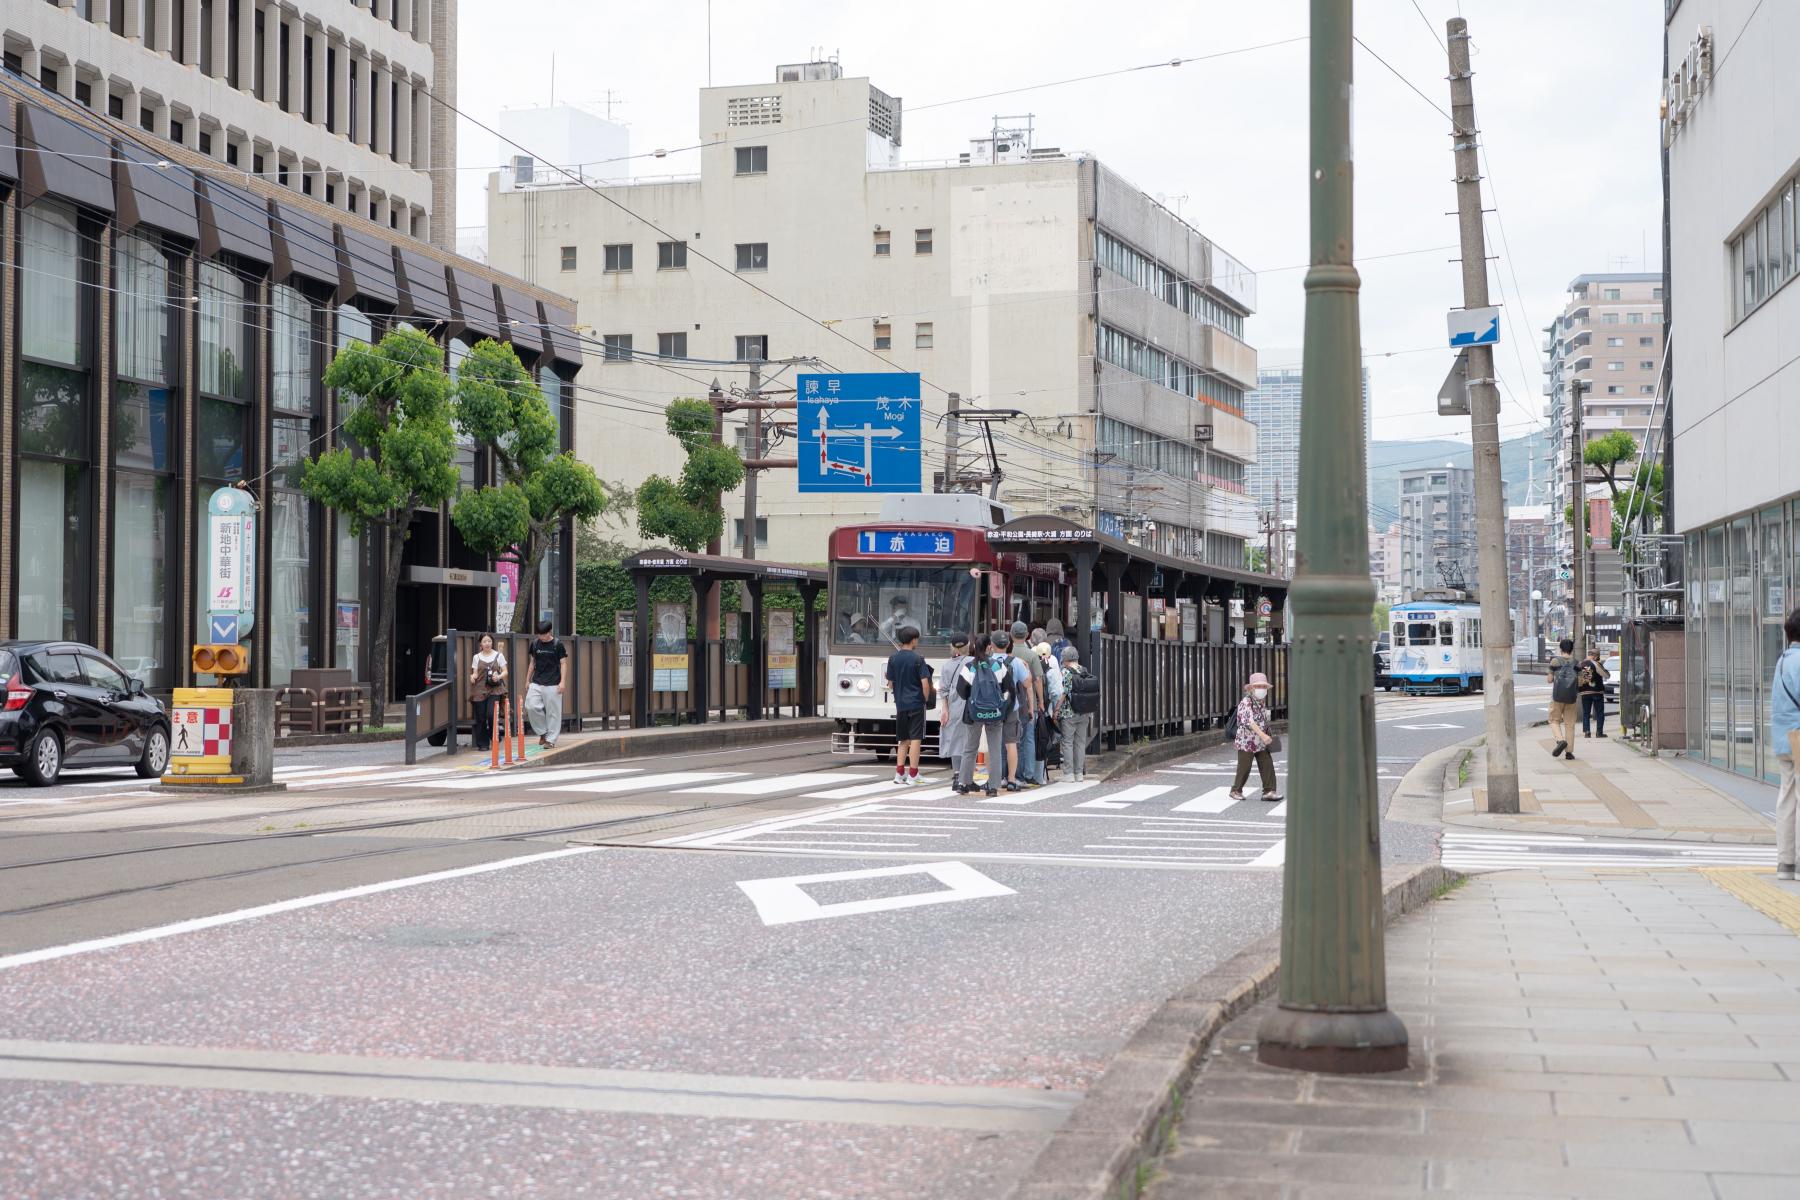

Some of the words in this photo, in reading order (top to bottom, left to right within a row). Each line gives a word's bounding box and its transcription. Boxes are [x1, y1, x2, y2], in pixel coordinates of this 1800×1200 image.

[805, 379, 840, 394] 諫早
[807, 396, 839, 405] Isahaya
[876, 396, 912, 411] 茂木
[884, 412, 905, 421] Mogi
[864, 531, 876, 552] 1
[1074, 530, 1093, 538] のりば
[219, 522, 231, 579] 新地中華街
[889, 537, 950, 553] 赤迫
[174, 711, 198, 724] 注意
